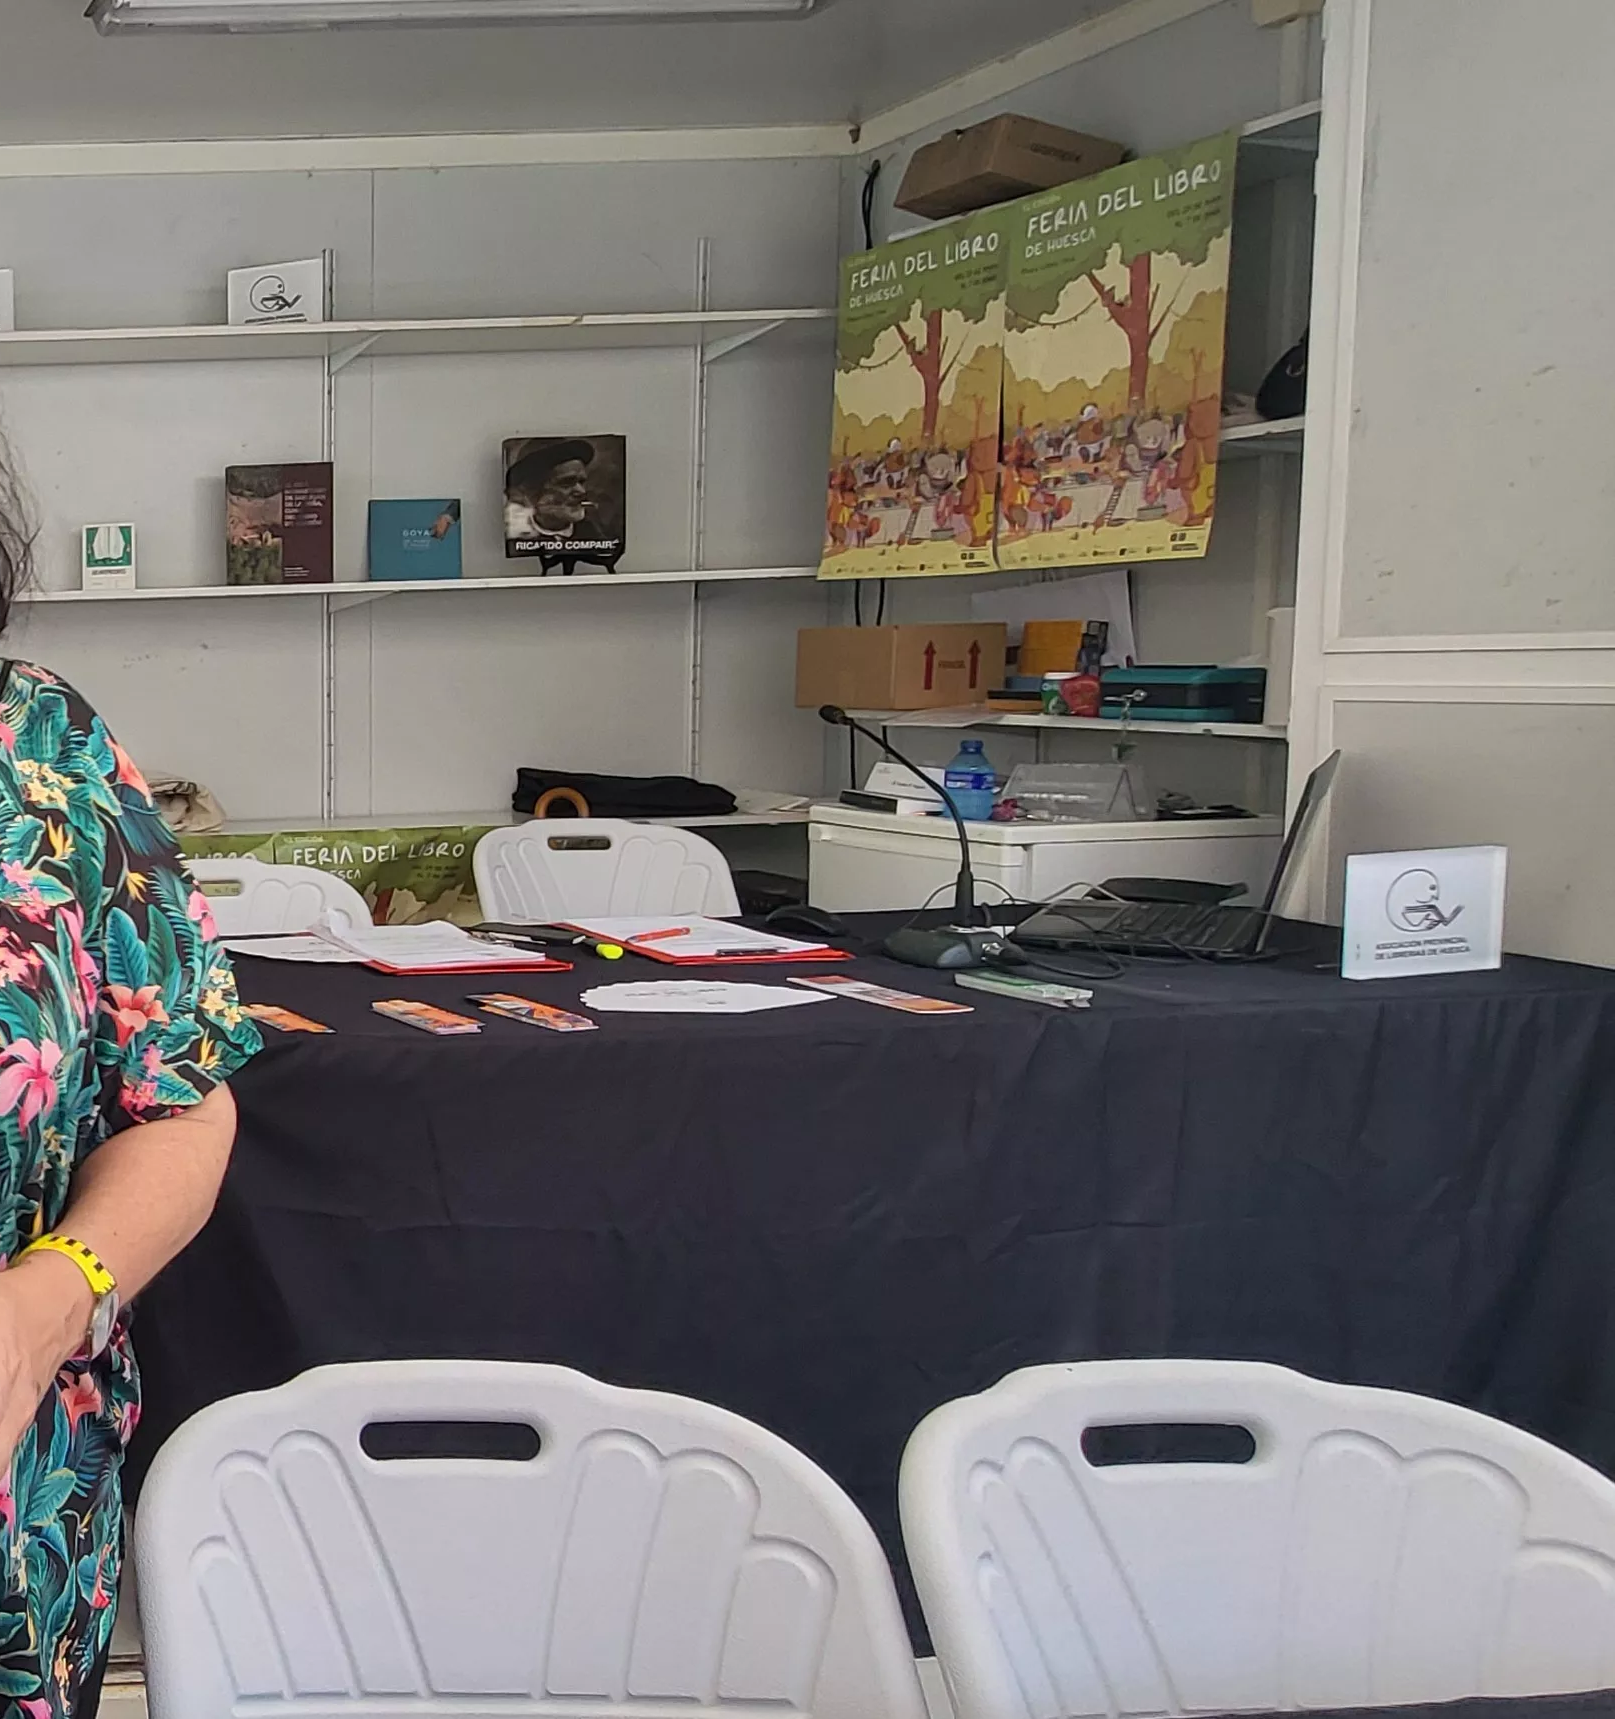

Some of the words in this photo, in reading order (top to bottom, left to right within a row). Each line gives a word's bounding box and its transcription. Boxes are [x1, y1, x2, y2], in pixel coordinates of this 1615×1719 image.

[1027, 201, 1088, 238] FERIA
[1097, 184, 1142, 216] DEL
[1154, 159, 1220, 201] LIBRO
[1025, 242, 1042, 258] DE
[1047, 227, 1096, 252] HUESCA
[851, 260, 897, 291] FERIA
[904, 250, 937, 275] DEL
[945, 232, 998, 265] LIBRO
[849, 296, 861, 308] DE
[865, 284, 904, 303] HUESCA
[293, 846, 353, 865] FERIA
[363, 845, 399, 863] DEL
[408, 842, 465, 858] LIBRO
